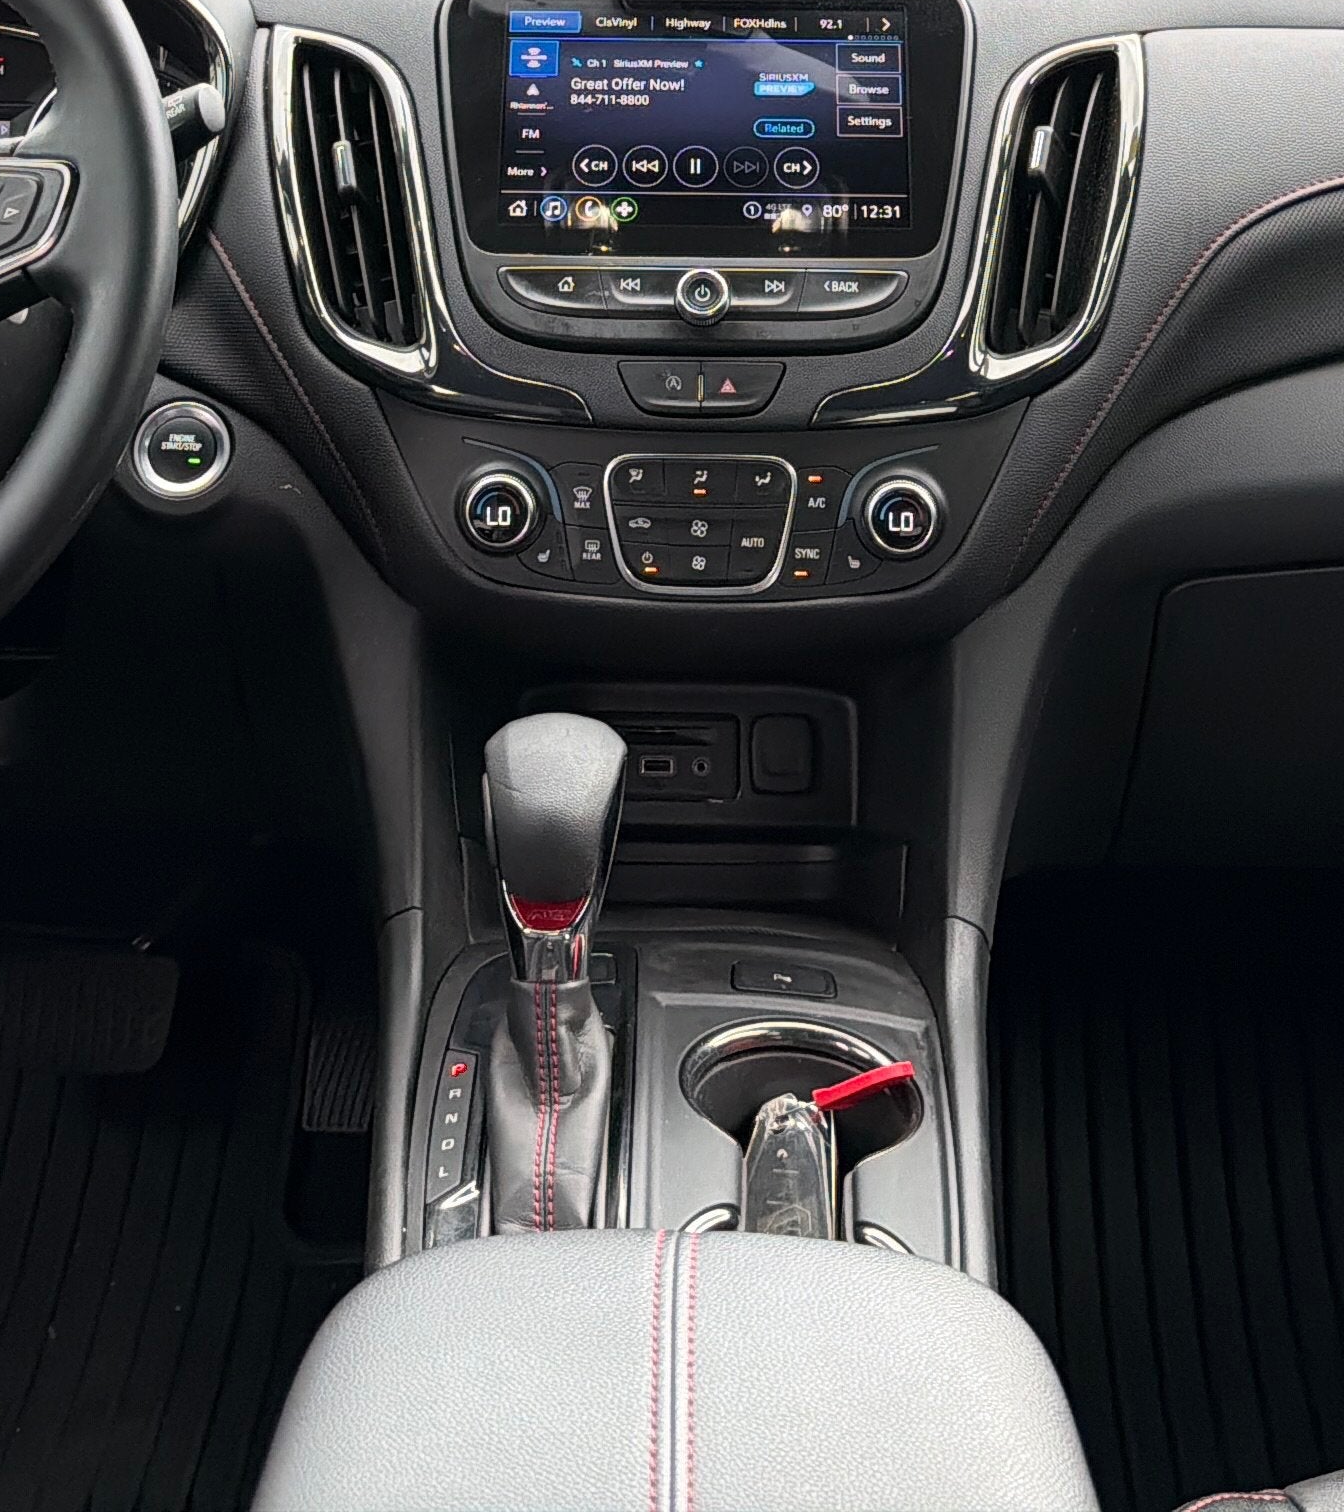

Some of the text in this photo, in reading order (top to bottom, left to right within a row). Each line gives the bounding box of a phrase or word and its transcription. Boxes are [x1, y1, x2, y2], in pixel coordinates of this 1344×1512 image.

[524, 16, 566, 27] Preview
[665, 18, 712, 32] Highway
[819, 19, 843, 29] 92.1
[851, 52, 886, 63] Sound
[586, 59, 601, 68] Ch
[613, 59, 653, 68] SiriusXM
[654, 59, 689, 69] Preview
[759, 73, 809, 82] SIRIUSXM
[570, 78, 686, 92] Great Offer Now!
[848, 84, 890, 95] Browse
[570, 94, 650, 106] 844-711-8800
[847, 116, 892, 129] Settings
[521, 129, 540, 139] FM
[764, 123, 804, 134] Related
[507, 167, 534, 176] More
[591, 161, 608, 171] CH
[783, 163, 801, 173] CH
[822, 204, 849, 218] 80°
[860, 205, 901, 219] 12:31
[830, 281, 859, 293] BACK
[160, 441, 203, 452] START/STOP
[574, 500, 591, 509] MAX
[808, 497, 826, 508] A/C
[486, 506, 511, 526] LO
[888, 512, 914, 532] LO
[741, 537, 765, 548] AUTO
[582, 551, 602, 561] REAR
[795, 548, 820, 560] SYNC
[451, 1063, 468, 1077] P
[449, 1088, 462, 1099] R
[445, 1113, 458, 1124] N
[441, 1138, 455, 1150] D
[438, 1166, 449, 1178] L
